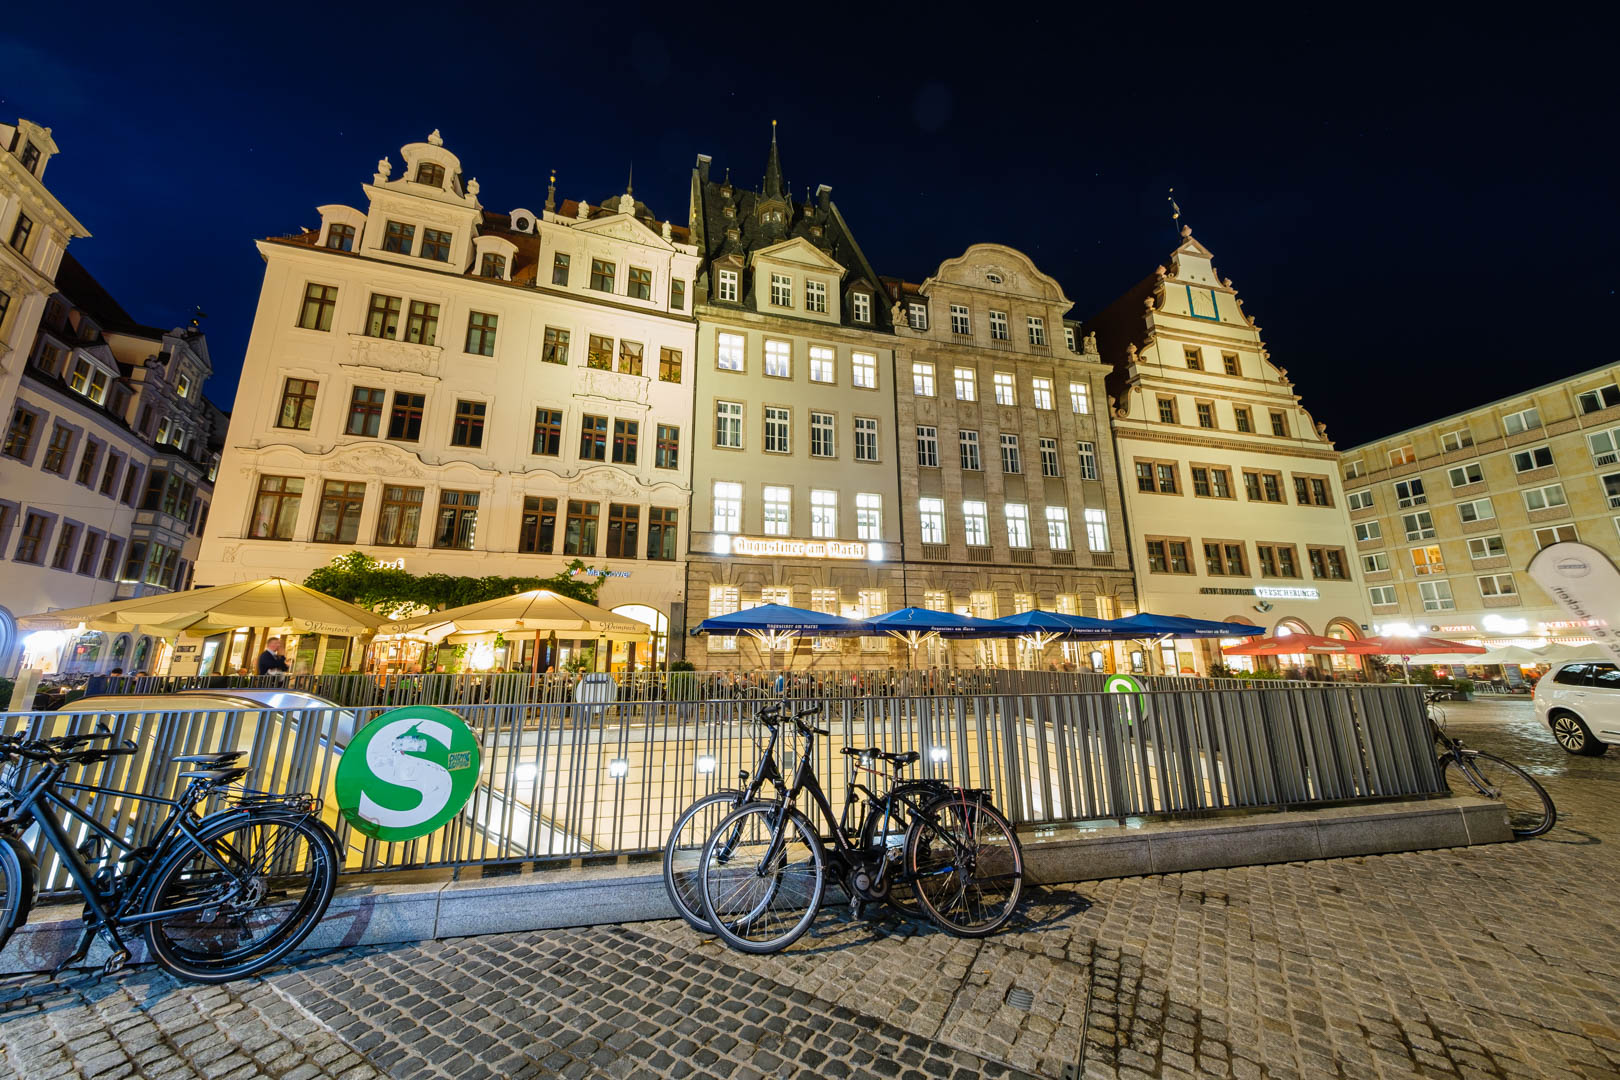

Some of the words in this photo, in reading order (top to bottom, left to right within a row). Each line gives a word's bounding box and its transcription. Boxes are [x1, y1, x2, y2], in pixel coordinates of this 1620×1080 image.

[737, 538, 804, 554] Augustiner
[808, 542, 825, 554] am
[831, 542, 865, 556] Markt
[304, 620, 351, 634] Weinstock
[358, 718, 453, 828] S
